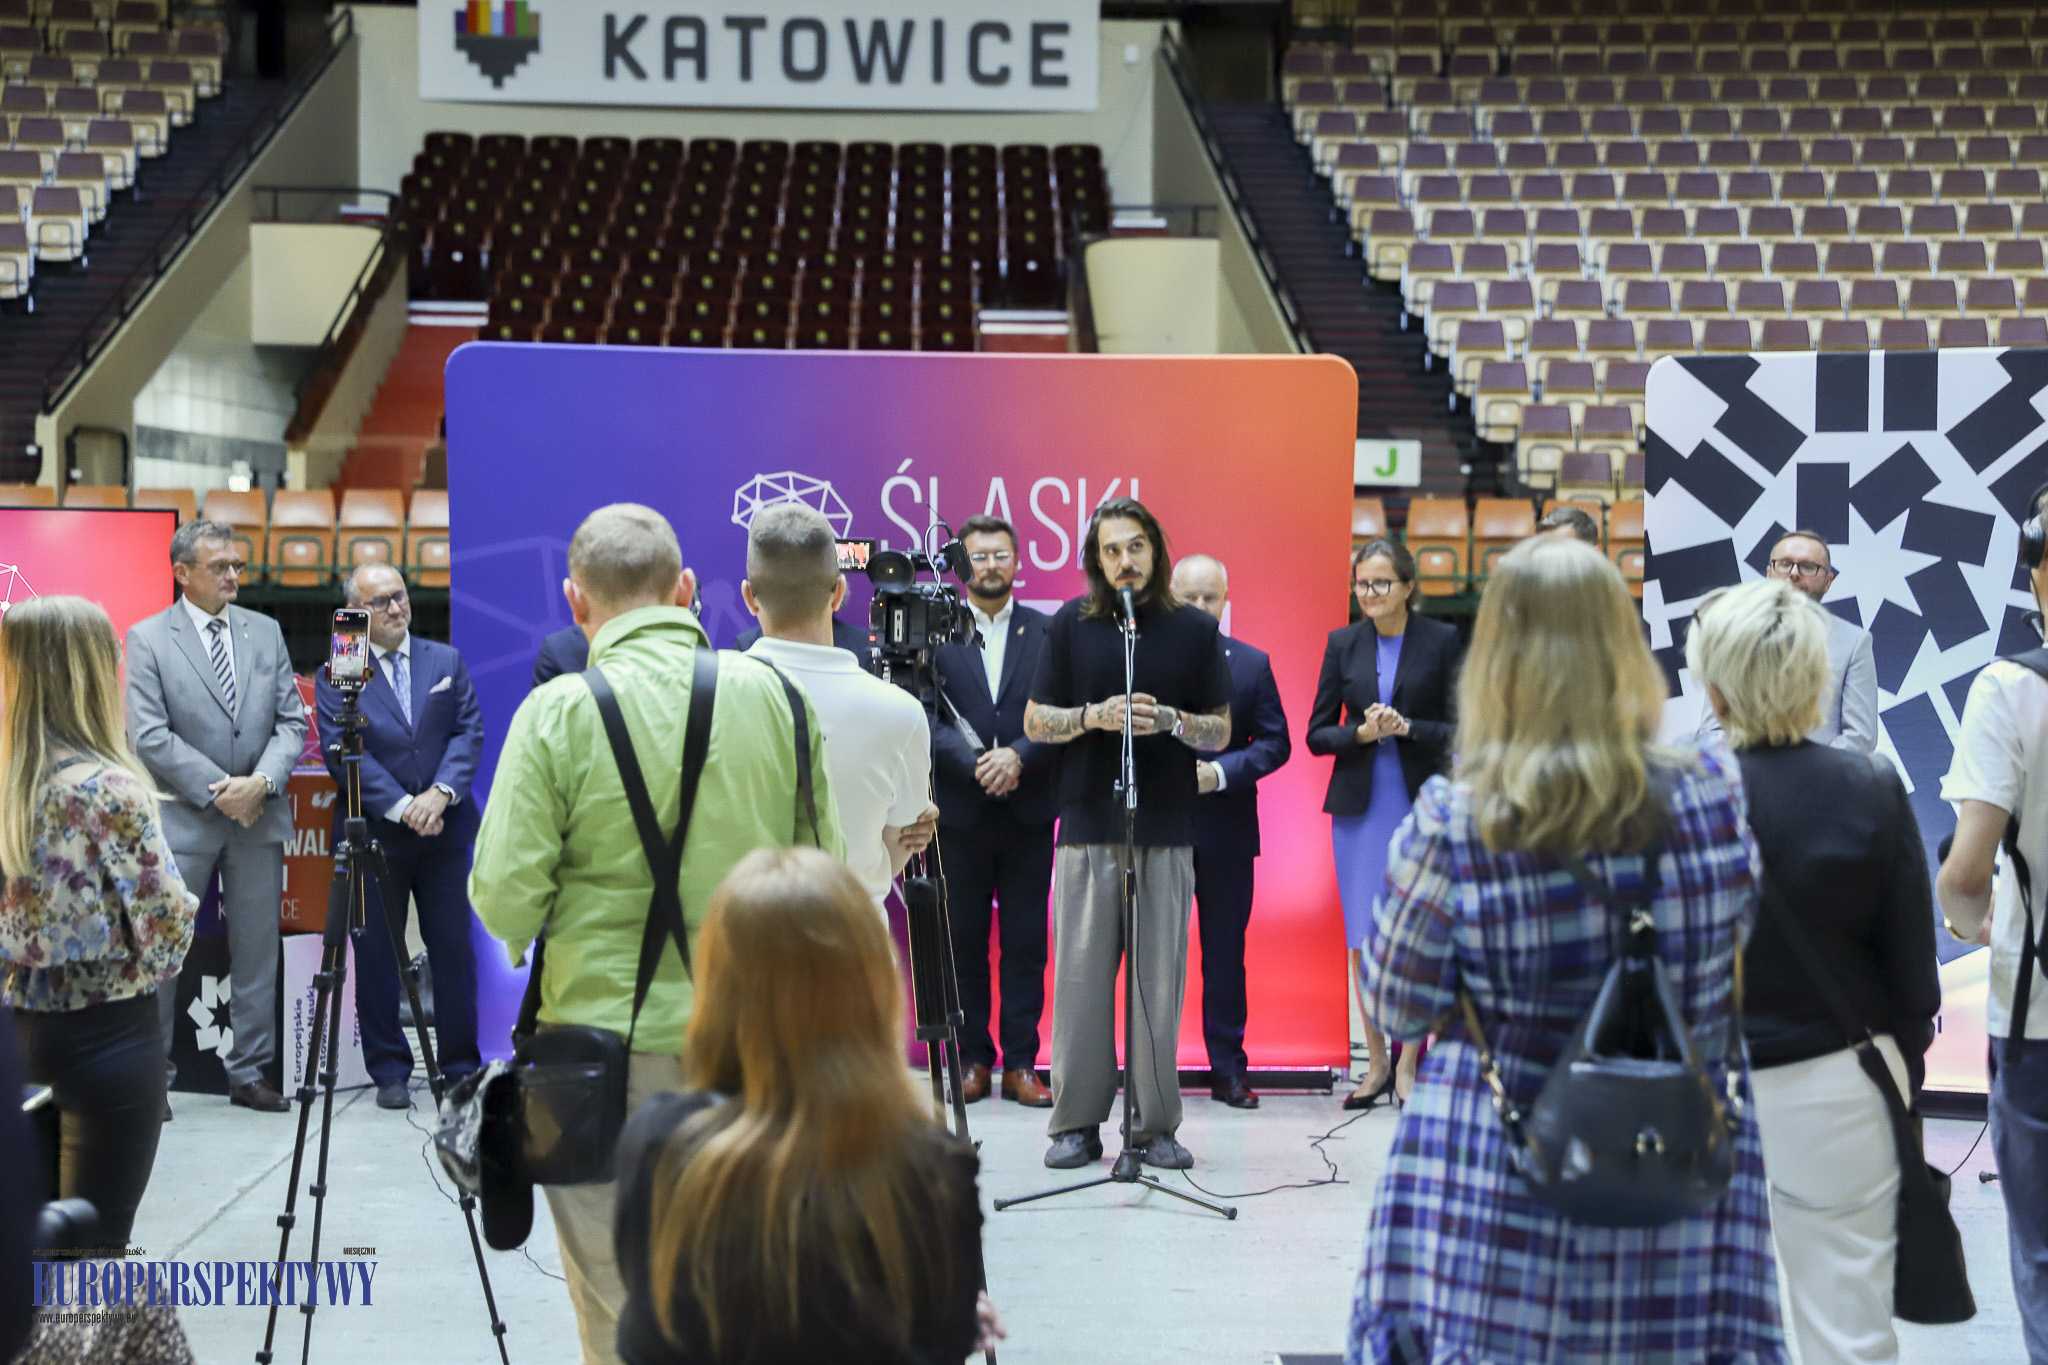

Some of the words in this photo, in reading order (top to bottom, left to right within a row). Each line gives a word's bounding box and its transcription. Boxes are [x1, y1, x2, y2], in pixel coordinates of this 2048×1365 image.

[602, 14, 1070, 87] KATOWICE
[1373, 447, 1398, 478] J
[294, 998, 304, 1083] Europejskie
